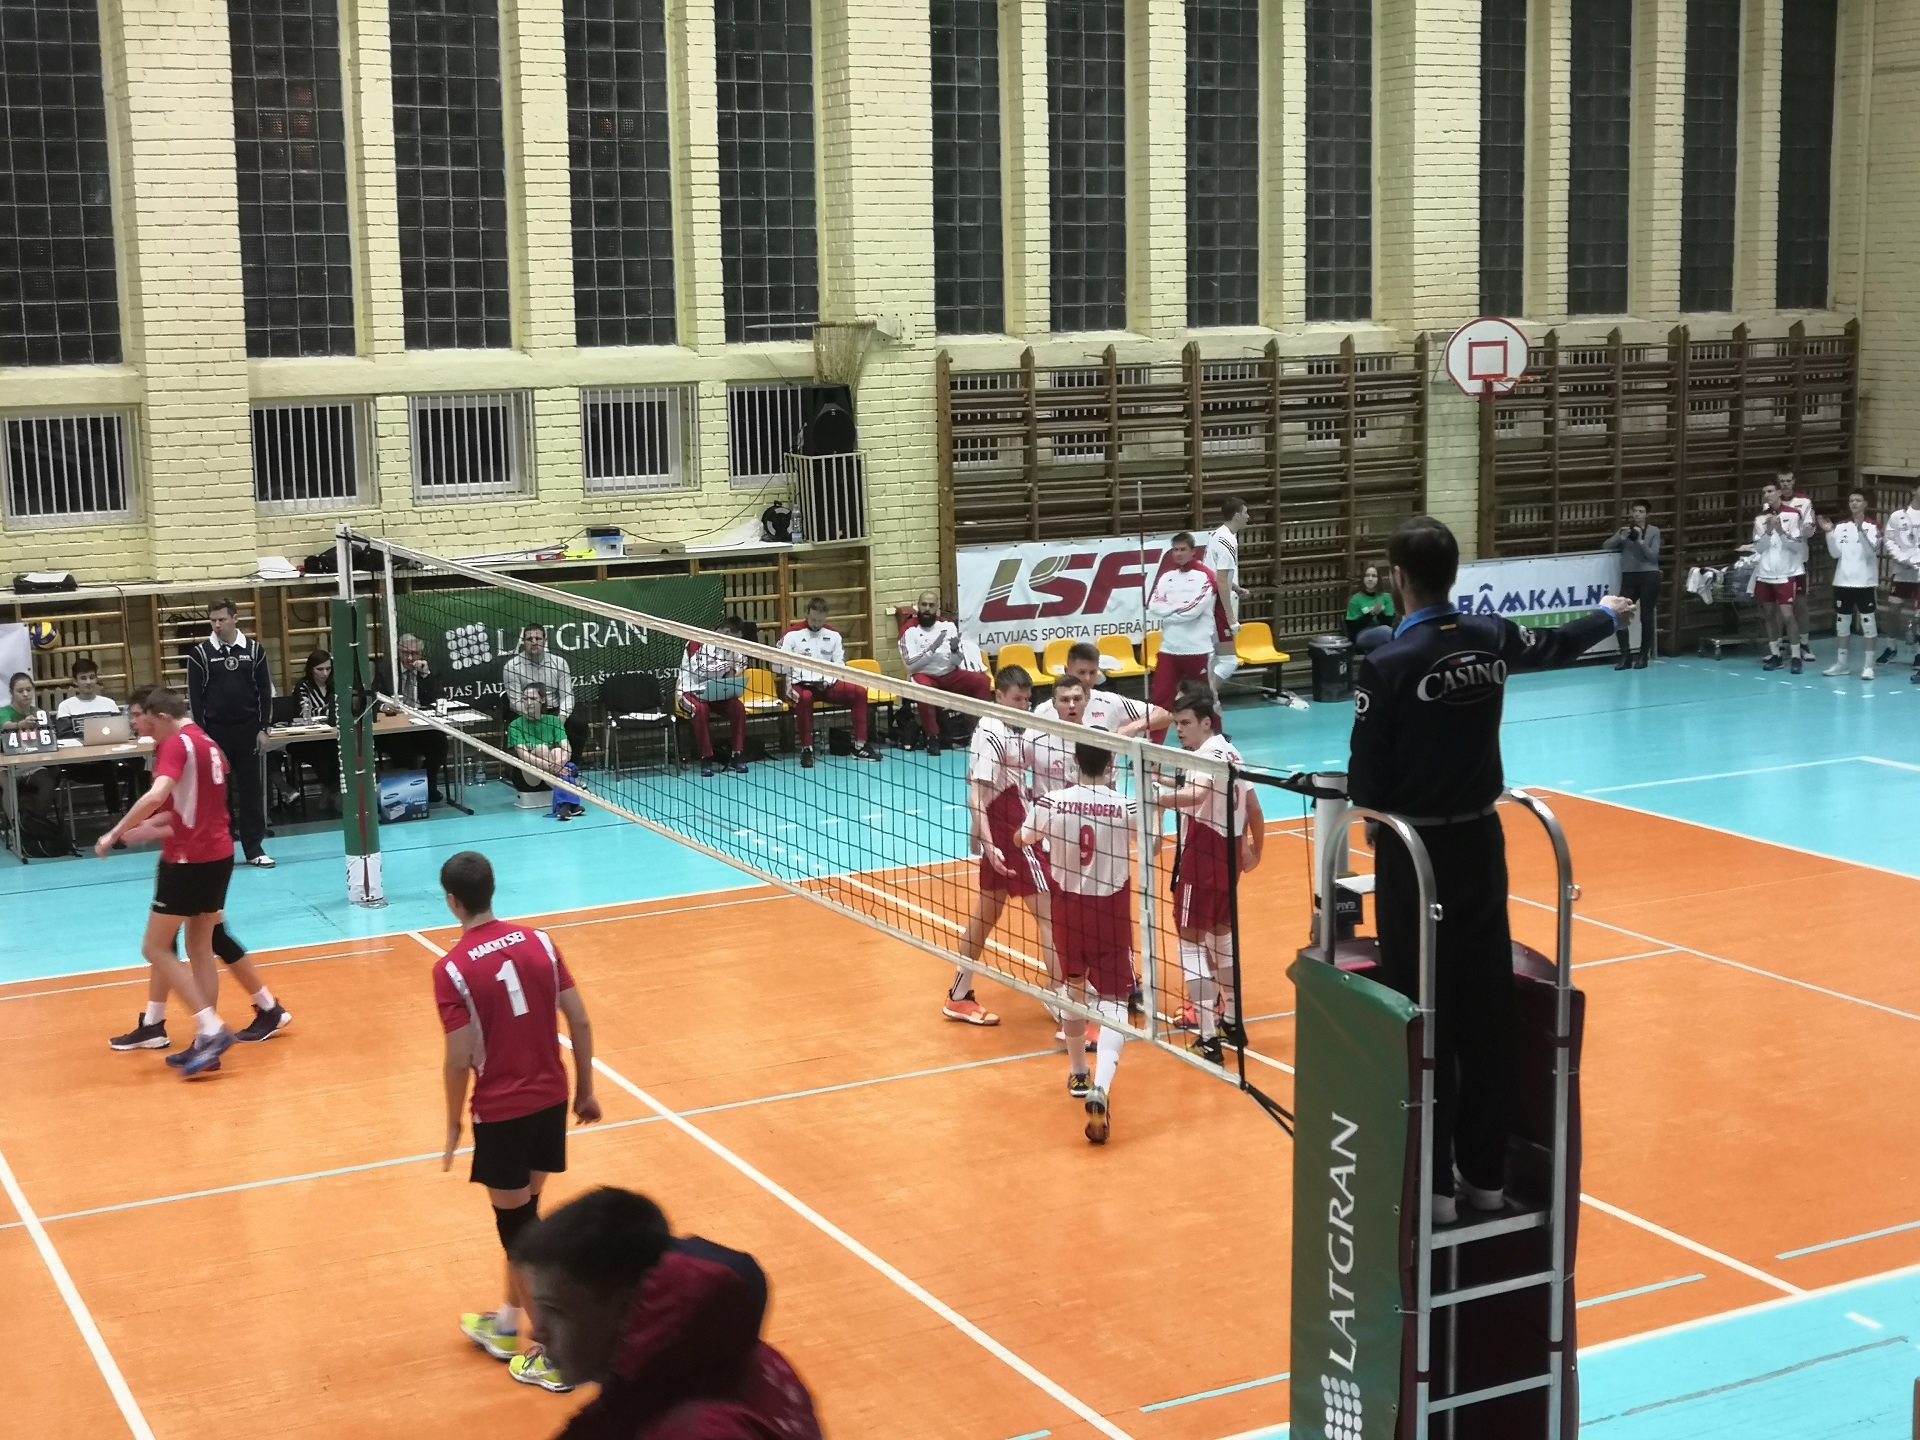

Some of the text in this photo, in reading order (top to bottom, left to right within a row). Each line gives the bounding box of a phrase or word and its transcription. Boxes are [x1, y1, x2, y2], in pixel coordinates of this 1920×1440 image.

[978, 619, 1164, 645] LATVIJAS SPORTA FEDERĀCIJ
[1417, 660, 1507, 701] CASINO
[36, 710, 48, 725] 9
[8, 732, 19, 748] 4
[40, 729, 51, 745] 6
[1079, 824, 1095, 867] 9
[495, 959, 530, 1017] 1
[1327, 1112, 1359, 1374] LATGRAN
